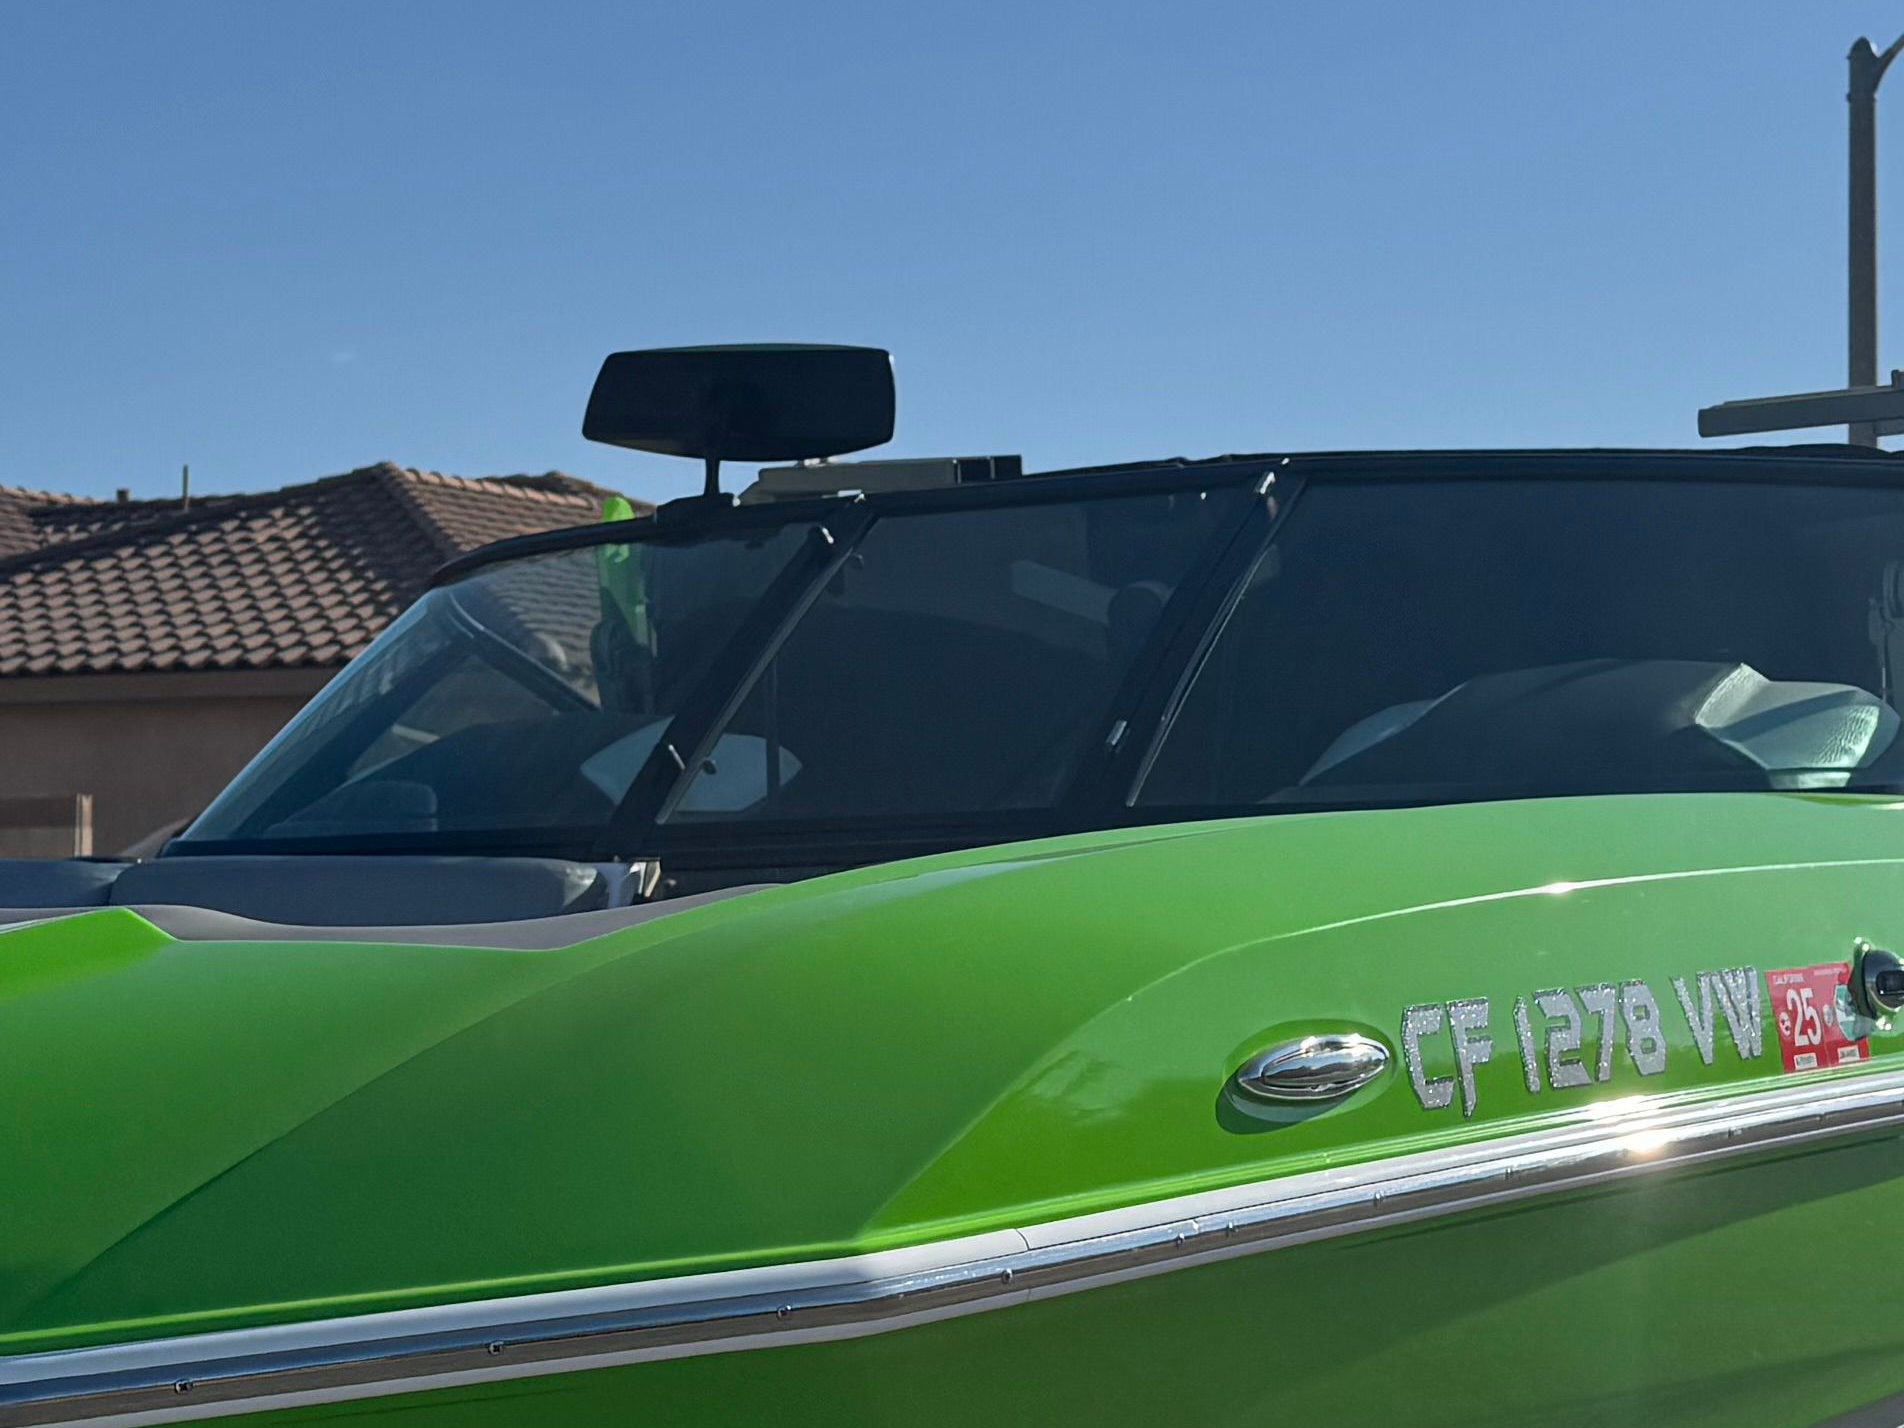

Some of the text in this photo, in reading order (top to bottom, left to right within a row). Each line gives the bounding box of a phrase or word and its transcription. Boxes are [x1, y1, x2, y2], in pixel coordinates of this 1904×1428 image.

[1401, 966, 1763, 1121] CF 1278 VW
[1786, 987, 1822, 1046] 25
